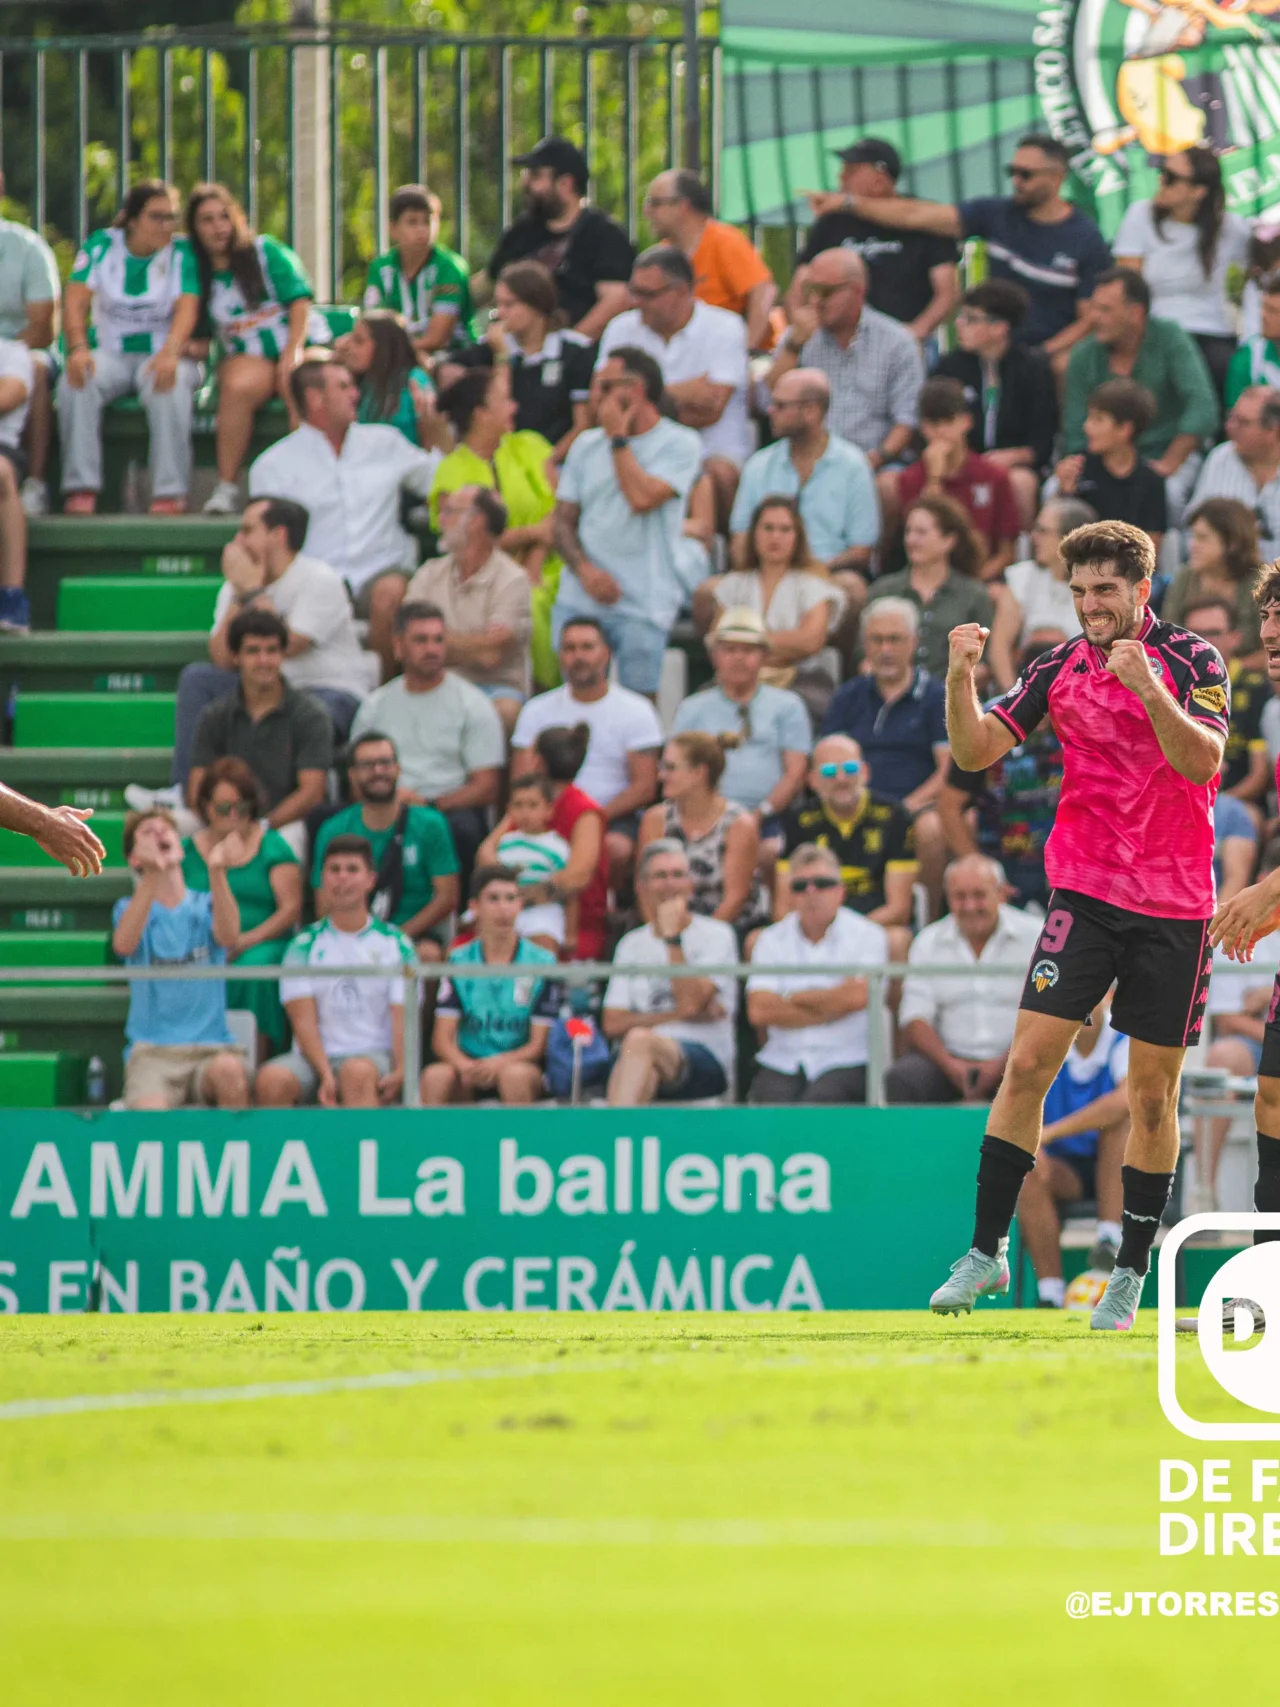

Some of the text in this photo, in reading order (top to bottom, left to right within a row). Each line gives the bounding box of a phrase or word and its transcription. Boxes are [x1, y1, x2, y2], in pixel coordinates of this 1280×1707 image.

[1040, 909, 1074, 954] 9
[10, 1136, 832, 1218] AMMA La ballena
[48, 1260, 139, 1313] EN
[169, 1246, 367, 1313] BAÑO
[391, 1257, 438, 1312] Y
[463, 1240, 825, 1311] CERÁMICA
